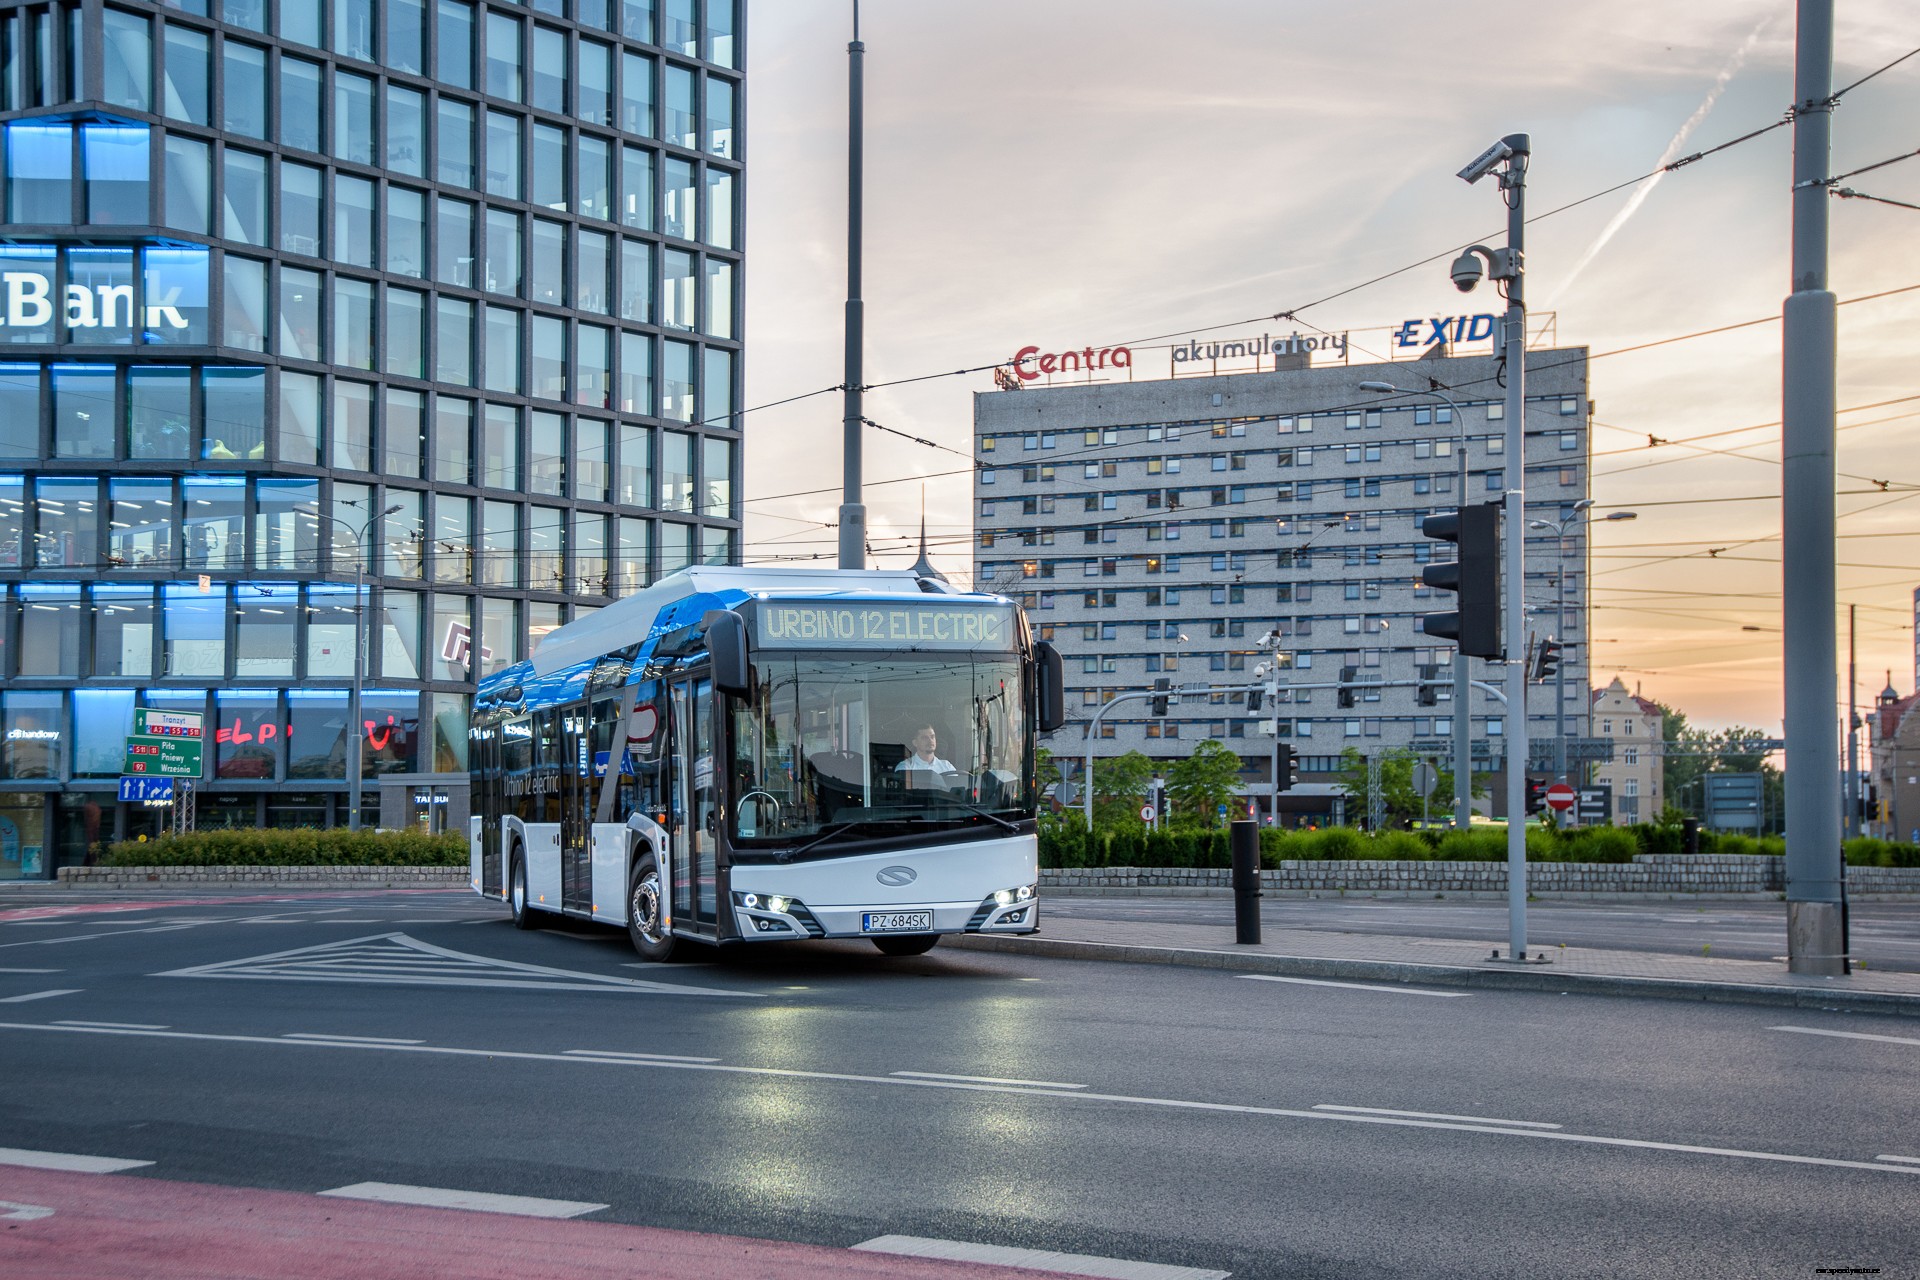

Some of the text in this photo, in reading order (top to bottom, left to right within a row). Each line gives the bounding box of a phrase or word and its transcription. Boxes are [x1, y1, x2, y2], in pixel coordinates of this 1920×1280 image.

[0, 270, 189, 328] Bank
[1394, 312, 1506, 347] EXID
[1173, 331, 1347, 364] akumulatory
[1013, 345, 1132, 380] Centra
[765, 609, 998, 641] URBINO 12 ELECTRIC
[162, 715, 186, 725] Tranzyt
[22, 730, 60, 741] handlowy
[172, 727, 181, 735] S5
[189, 728, 199, 736] S11
[136, 763, 191, 773] 92 Września
[161, 753, 185, 763] Pniewy
[503, 769, 559, 797] Urbino 12 electric
[872, 914, 926, 928] PZ 684SK
